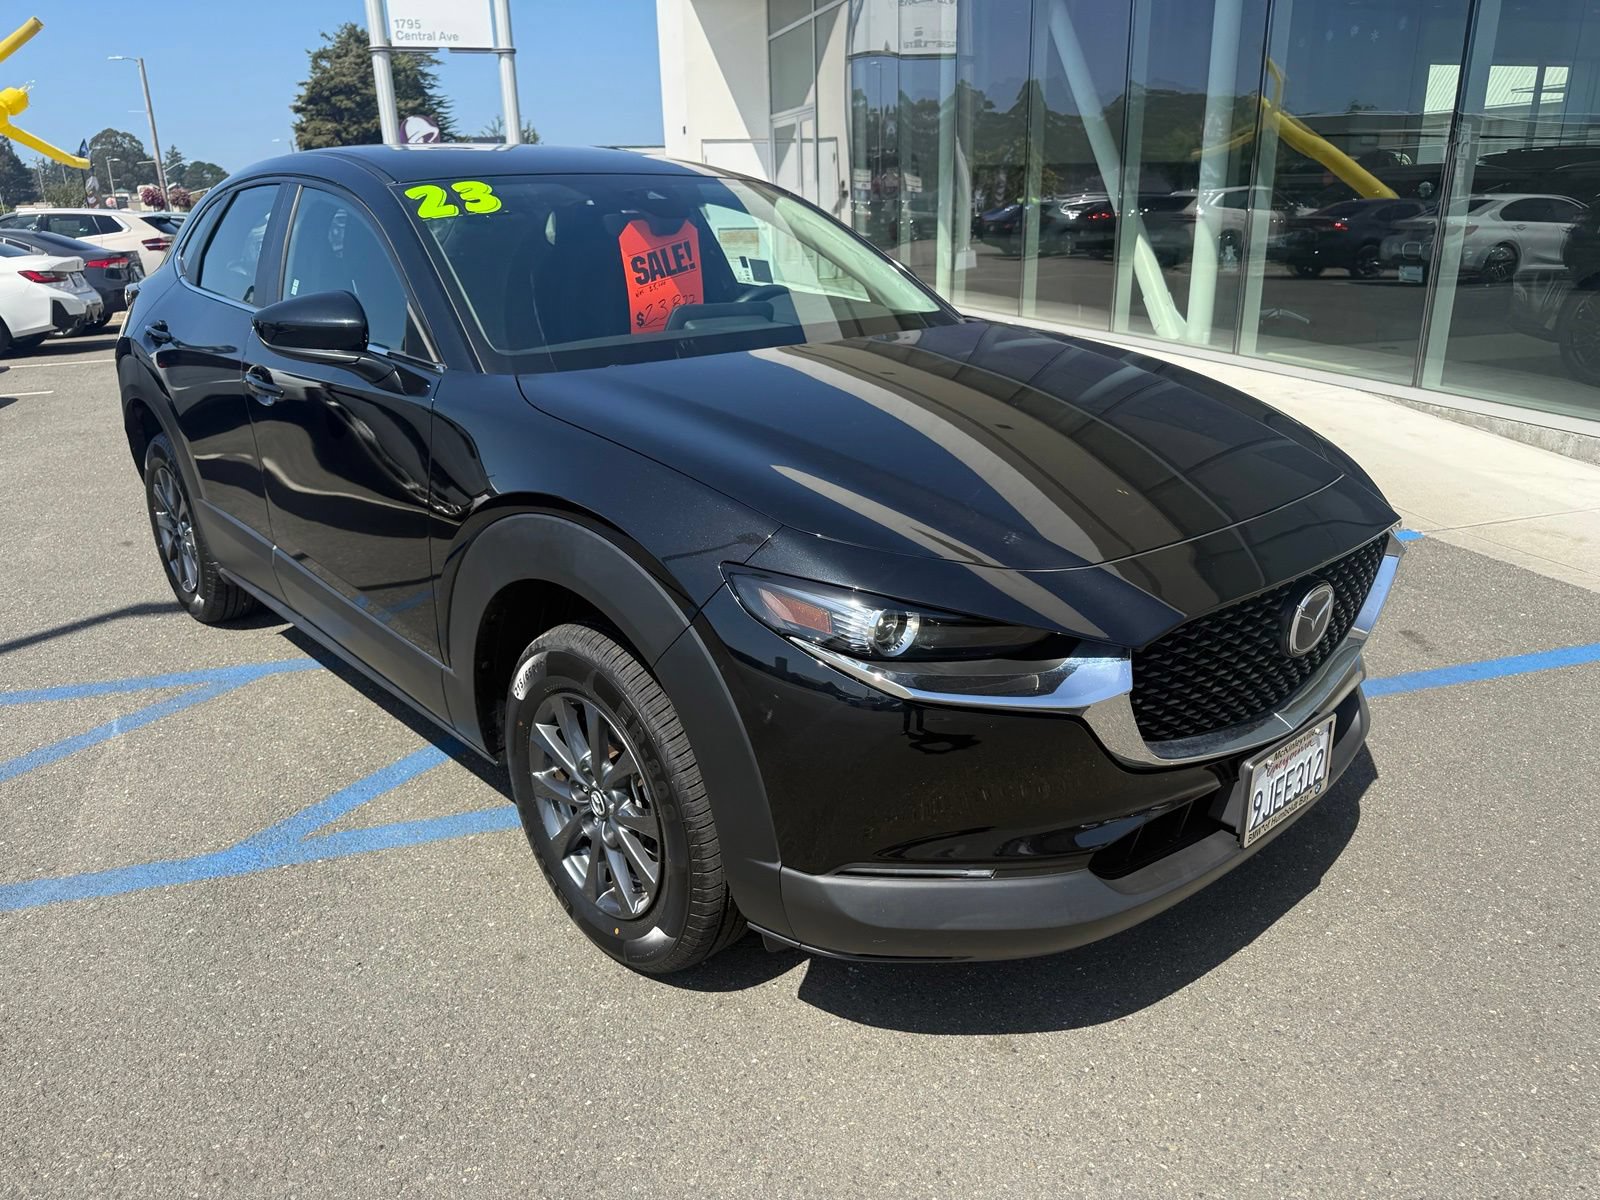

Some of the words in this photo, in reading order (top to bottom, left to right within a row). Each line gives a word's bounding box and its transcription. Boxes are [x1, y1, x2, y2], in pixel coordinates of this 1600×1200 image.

[394, 19, 421, 29] 1795
[395, 31, 436, 41] Central
[439, 32, 459, 41] Ave
[404, 181, 502, 219] 23
[631, 240, 696, 285] SALE!
[1249, 748, 1325, 833] 9JEE312
